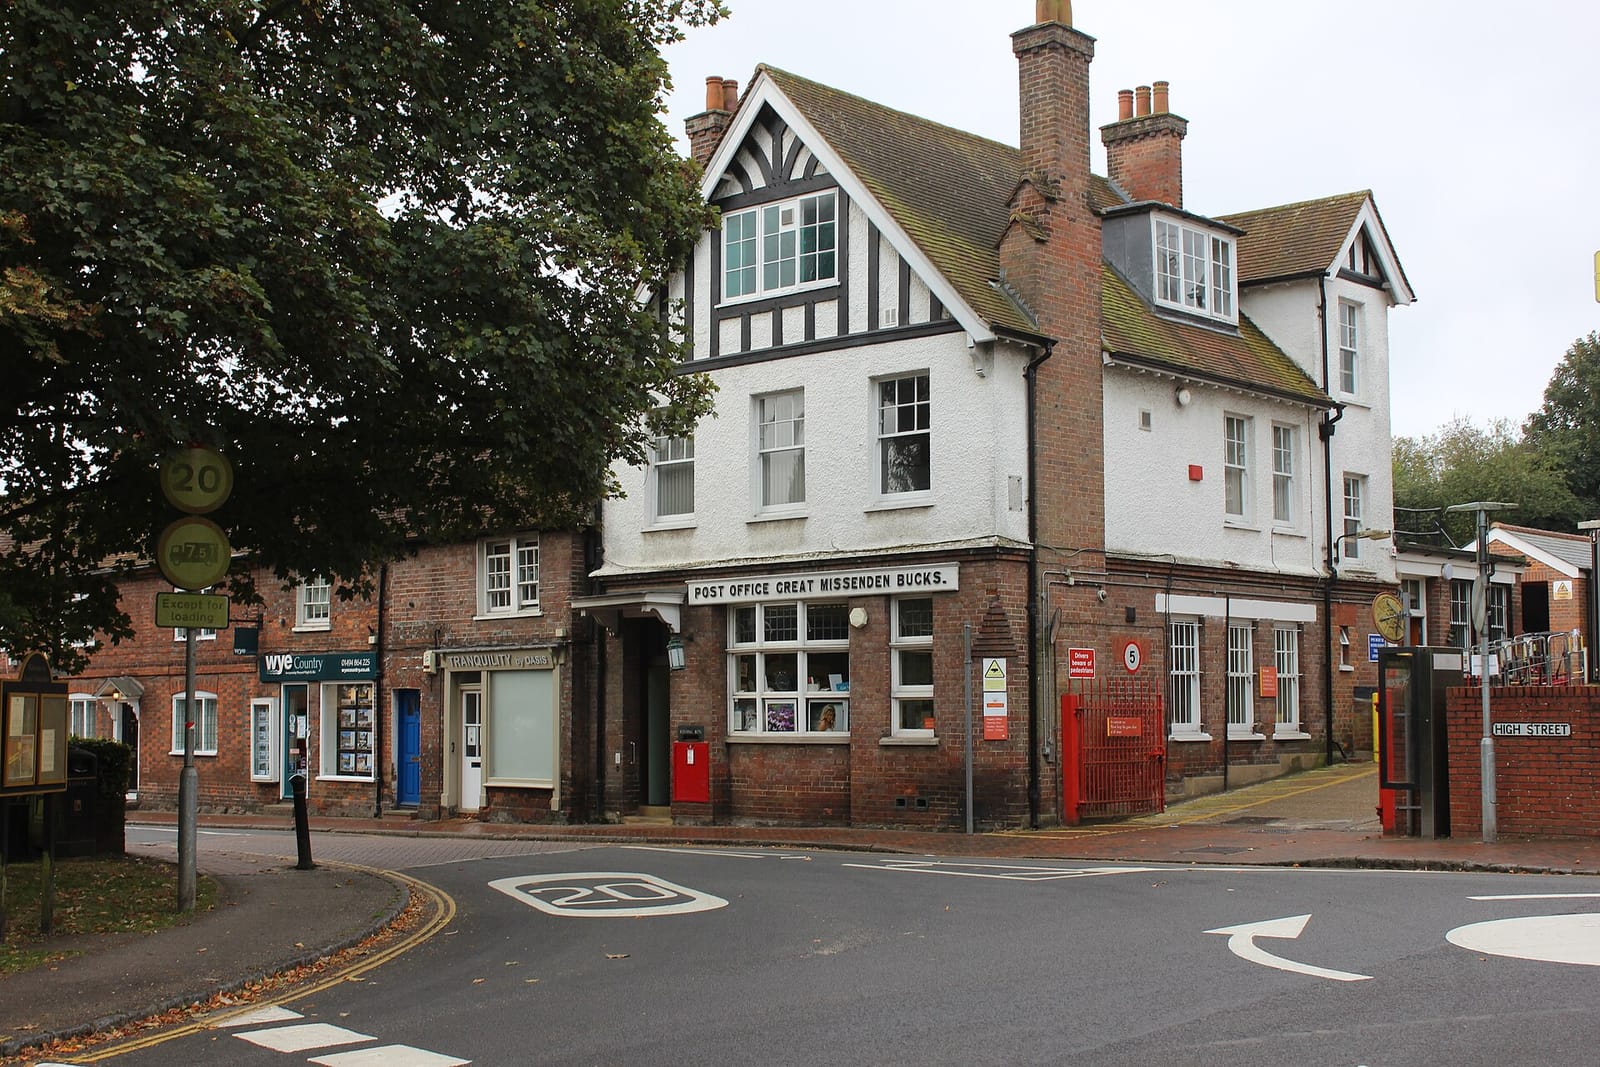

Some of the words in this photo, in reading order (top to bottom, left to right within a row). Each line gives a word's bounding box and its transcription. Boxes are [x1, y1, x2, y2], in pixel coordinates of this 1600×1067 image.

[172, 464, 220, 493] 20
[694, 586, 724, 599] POST
[729, 582, 769, 597] OFFICE
[776, 579, 814, 593] GREAT
[820, 574, 890, 591] MISSENDEN
[897, 571, 947, 587] BUCKS.
[162, 599, 202, 611] Except
[208, 601, 223, 610] for
[172, 611, 213, 624] loading
[448, 653, 512, 668] TRANQUILITY
[526, 655, 547, 665] OASIS
[1129, 651, 1136, 663] 5
[265, 655, 293, 675] wye
[293, 656, 324, 673] Country
[1495, 724, 1521, 735] HIGH
[1526, 724, 1568, 735] STREET
[528, 883, 678, 907] 20
